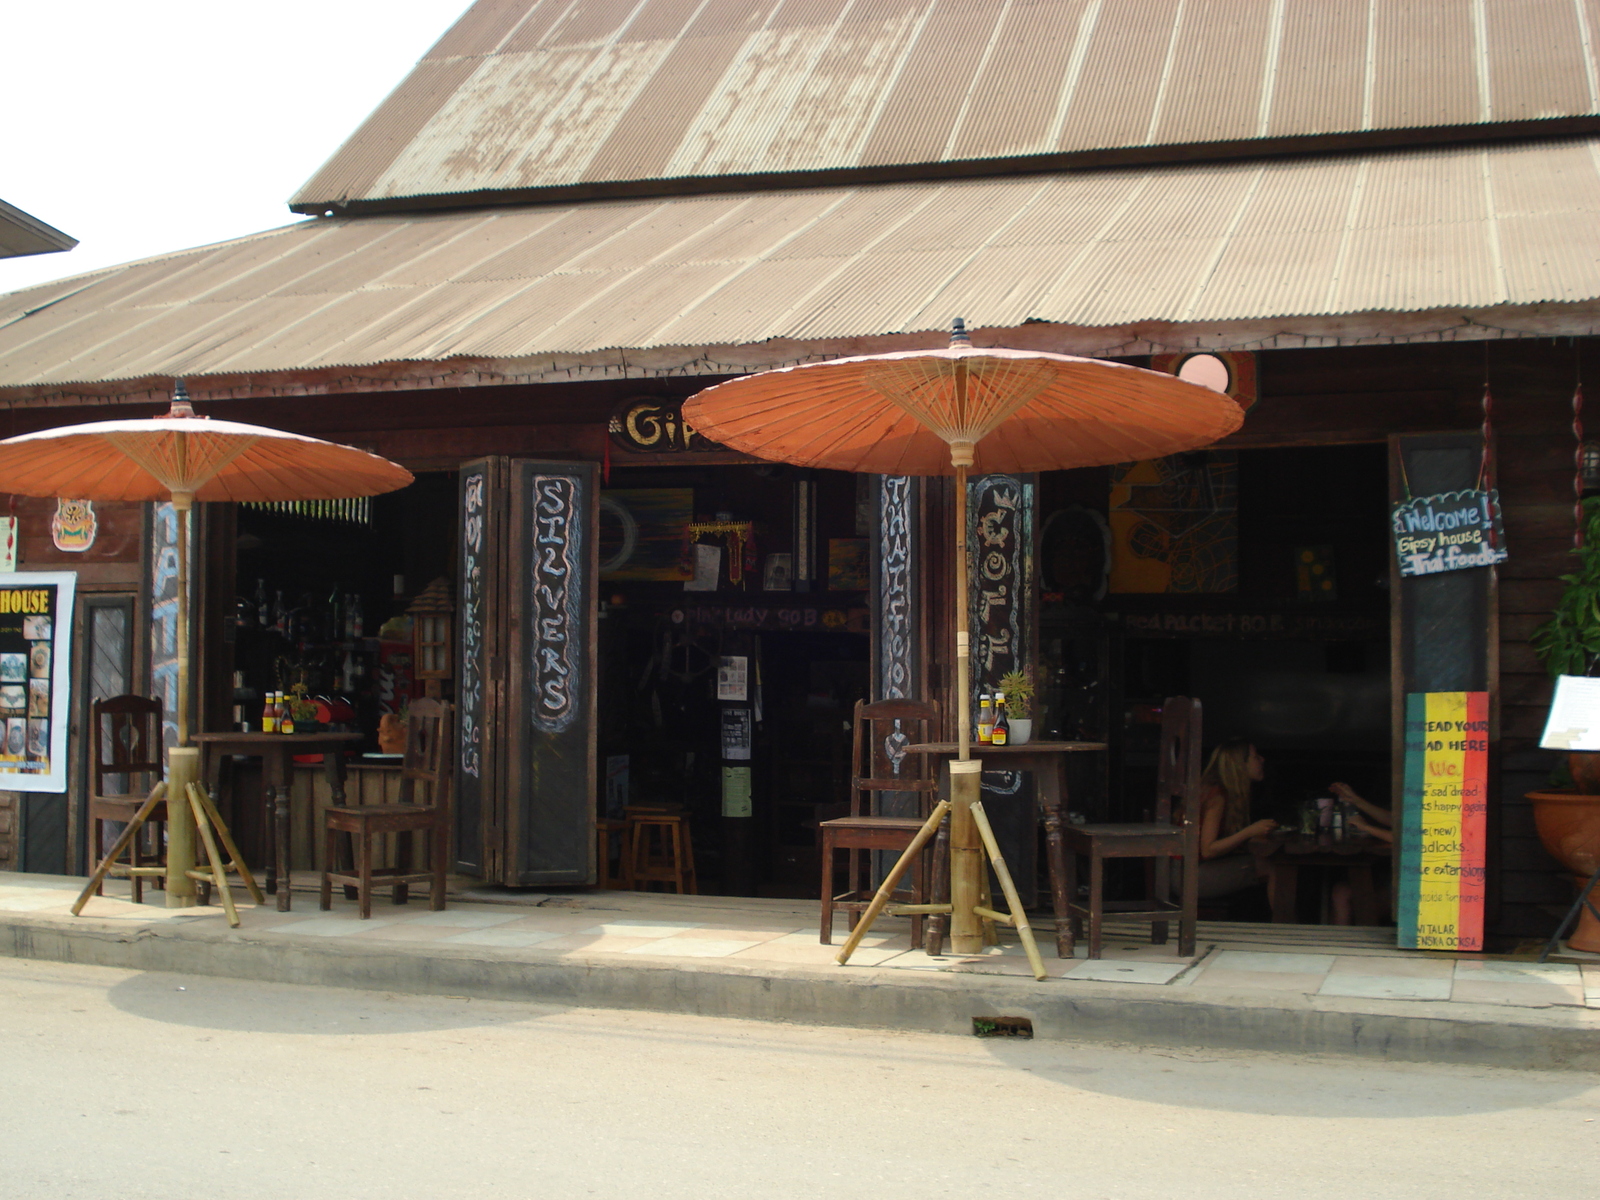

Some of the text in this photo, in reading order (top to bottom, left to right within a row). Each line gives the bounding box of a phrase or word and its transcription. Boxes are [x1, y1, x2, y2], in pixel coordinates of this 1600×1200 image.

[626, 403, 698, 451] Gip
[1439, 529, 1482, 547] house
[0, 589, 49, 614] HOUSE
[538, 481, 568, 711] SILVERS
[1455, 720, 1488, 732] YOUR
[1449, 740, 1487, 752] HERE
[1428, 924, 1455, 935] TALAR
[1405, 935, 1444, 947] ENSKA
